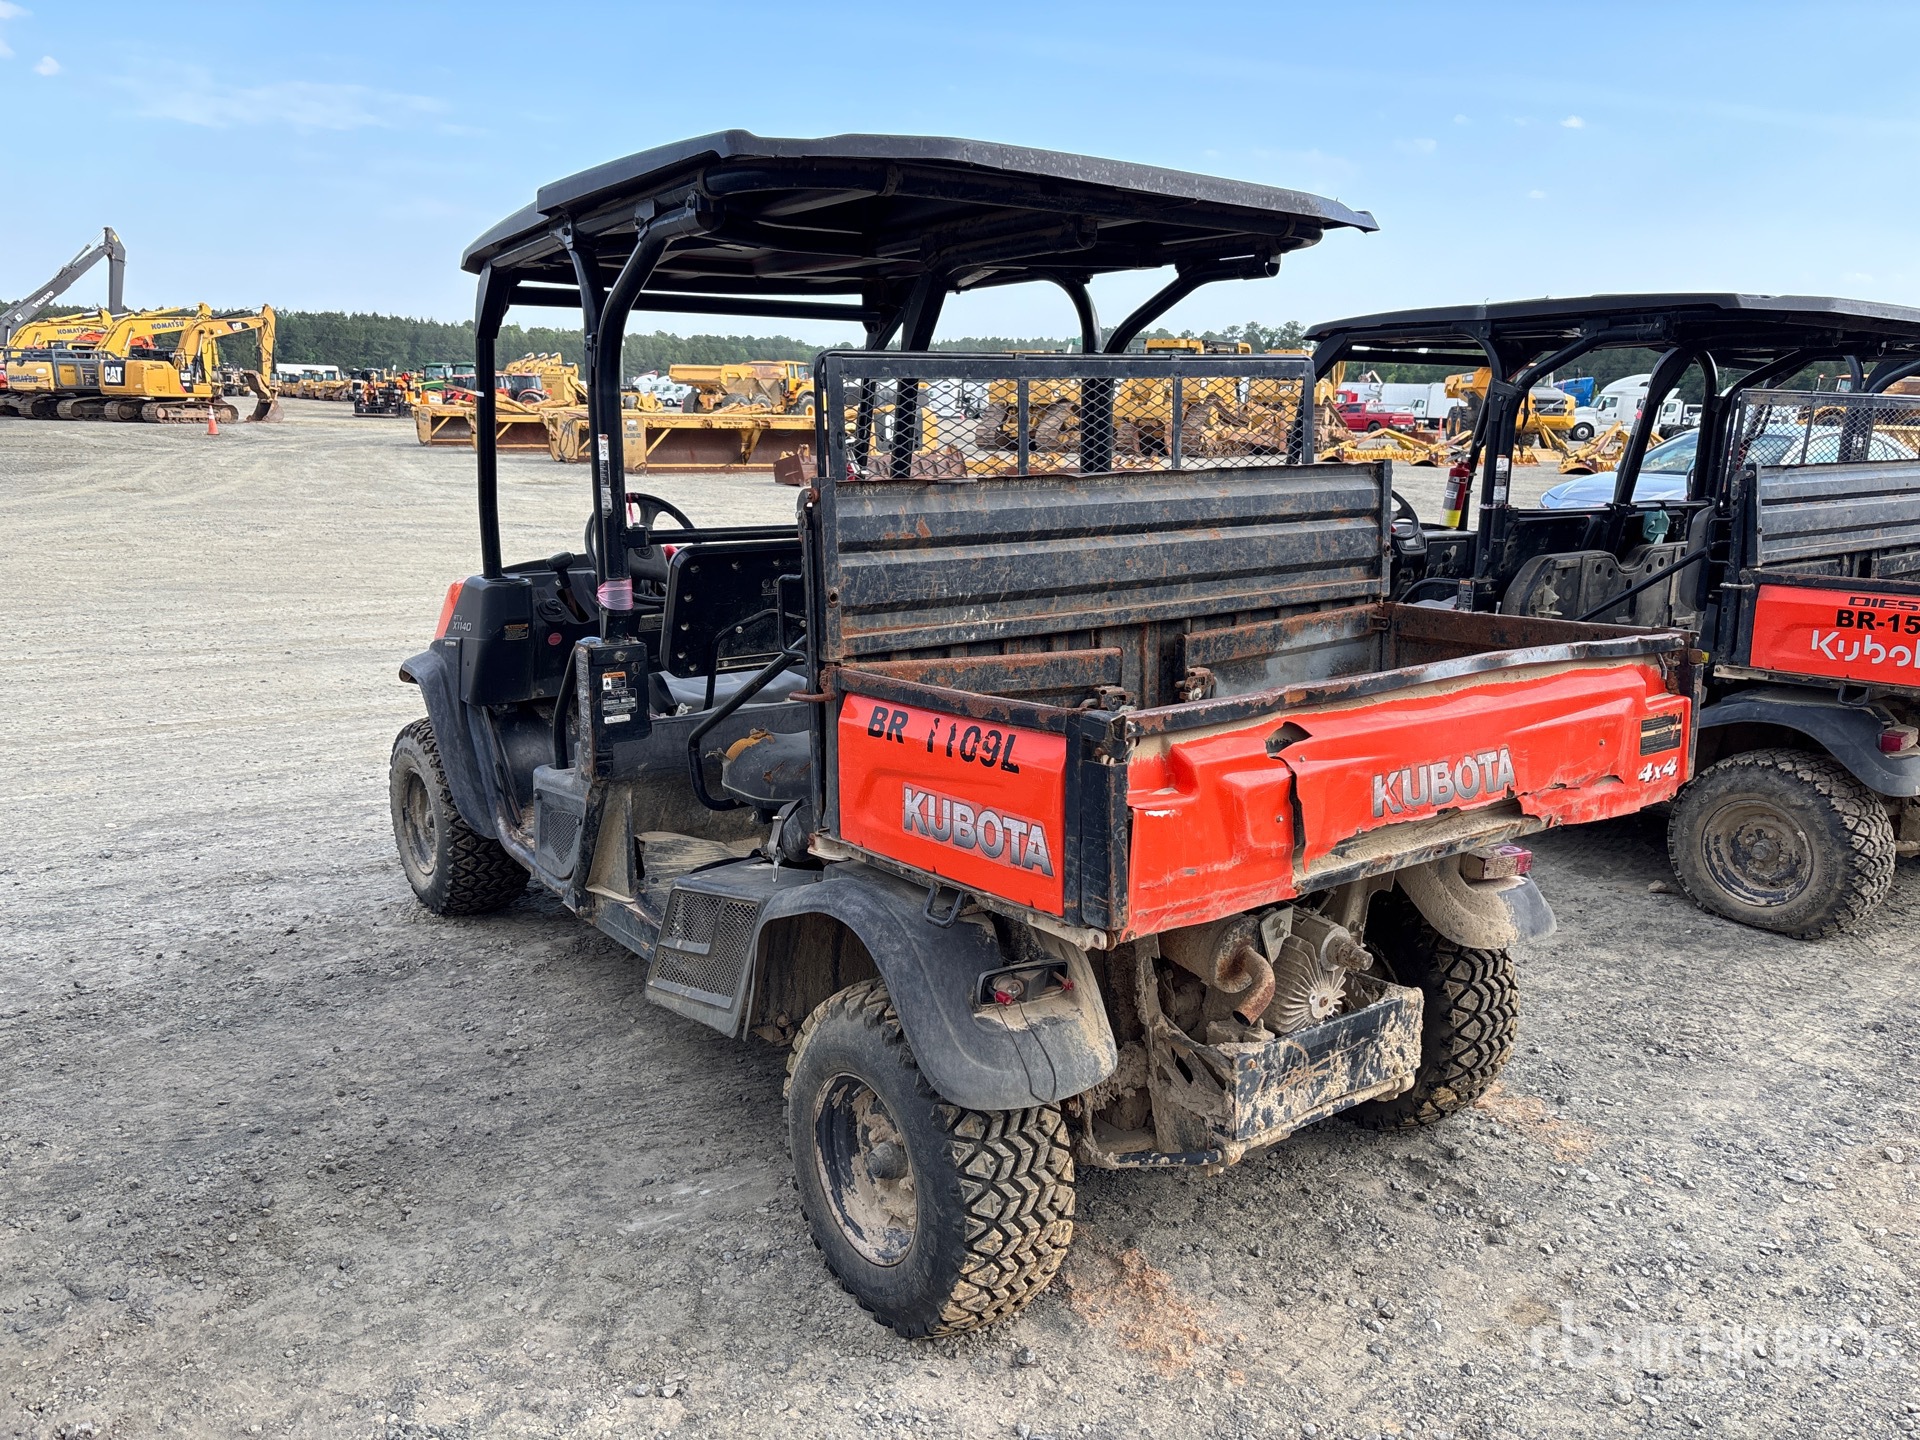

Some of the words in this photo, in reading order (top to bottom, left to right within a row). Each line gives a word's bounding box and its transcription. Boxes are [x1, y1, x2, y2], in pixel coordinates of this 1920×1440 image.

[32, 290, 54, 308] VOLVO
[57, 327, 89, 335] KOMATSU
[151, 320, 185, 330] KOMATSU
[104, 366, 122, 383] CAT
[1848, 596, 1920, 611] DIES
[452, 621, 472, 632] X1140
[1836, 609, 1920, 635] BR-15
[867, 705, 909, 744] BR
[926, 717, 1020, 774] 1109L
[1638, 756, 1678, 783] 4x4
[1372, 747, 1517, 819] KUBOTA
[903, 786, 1055, 878] KUBOTA
